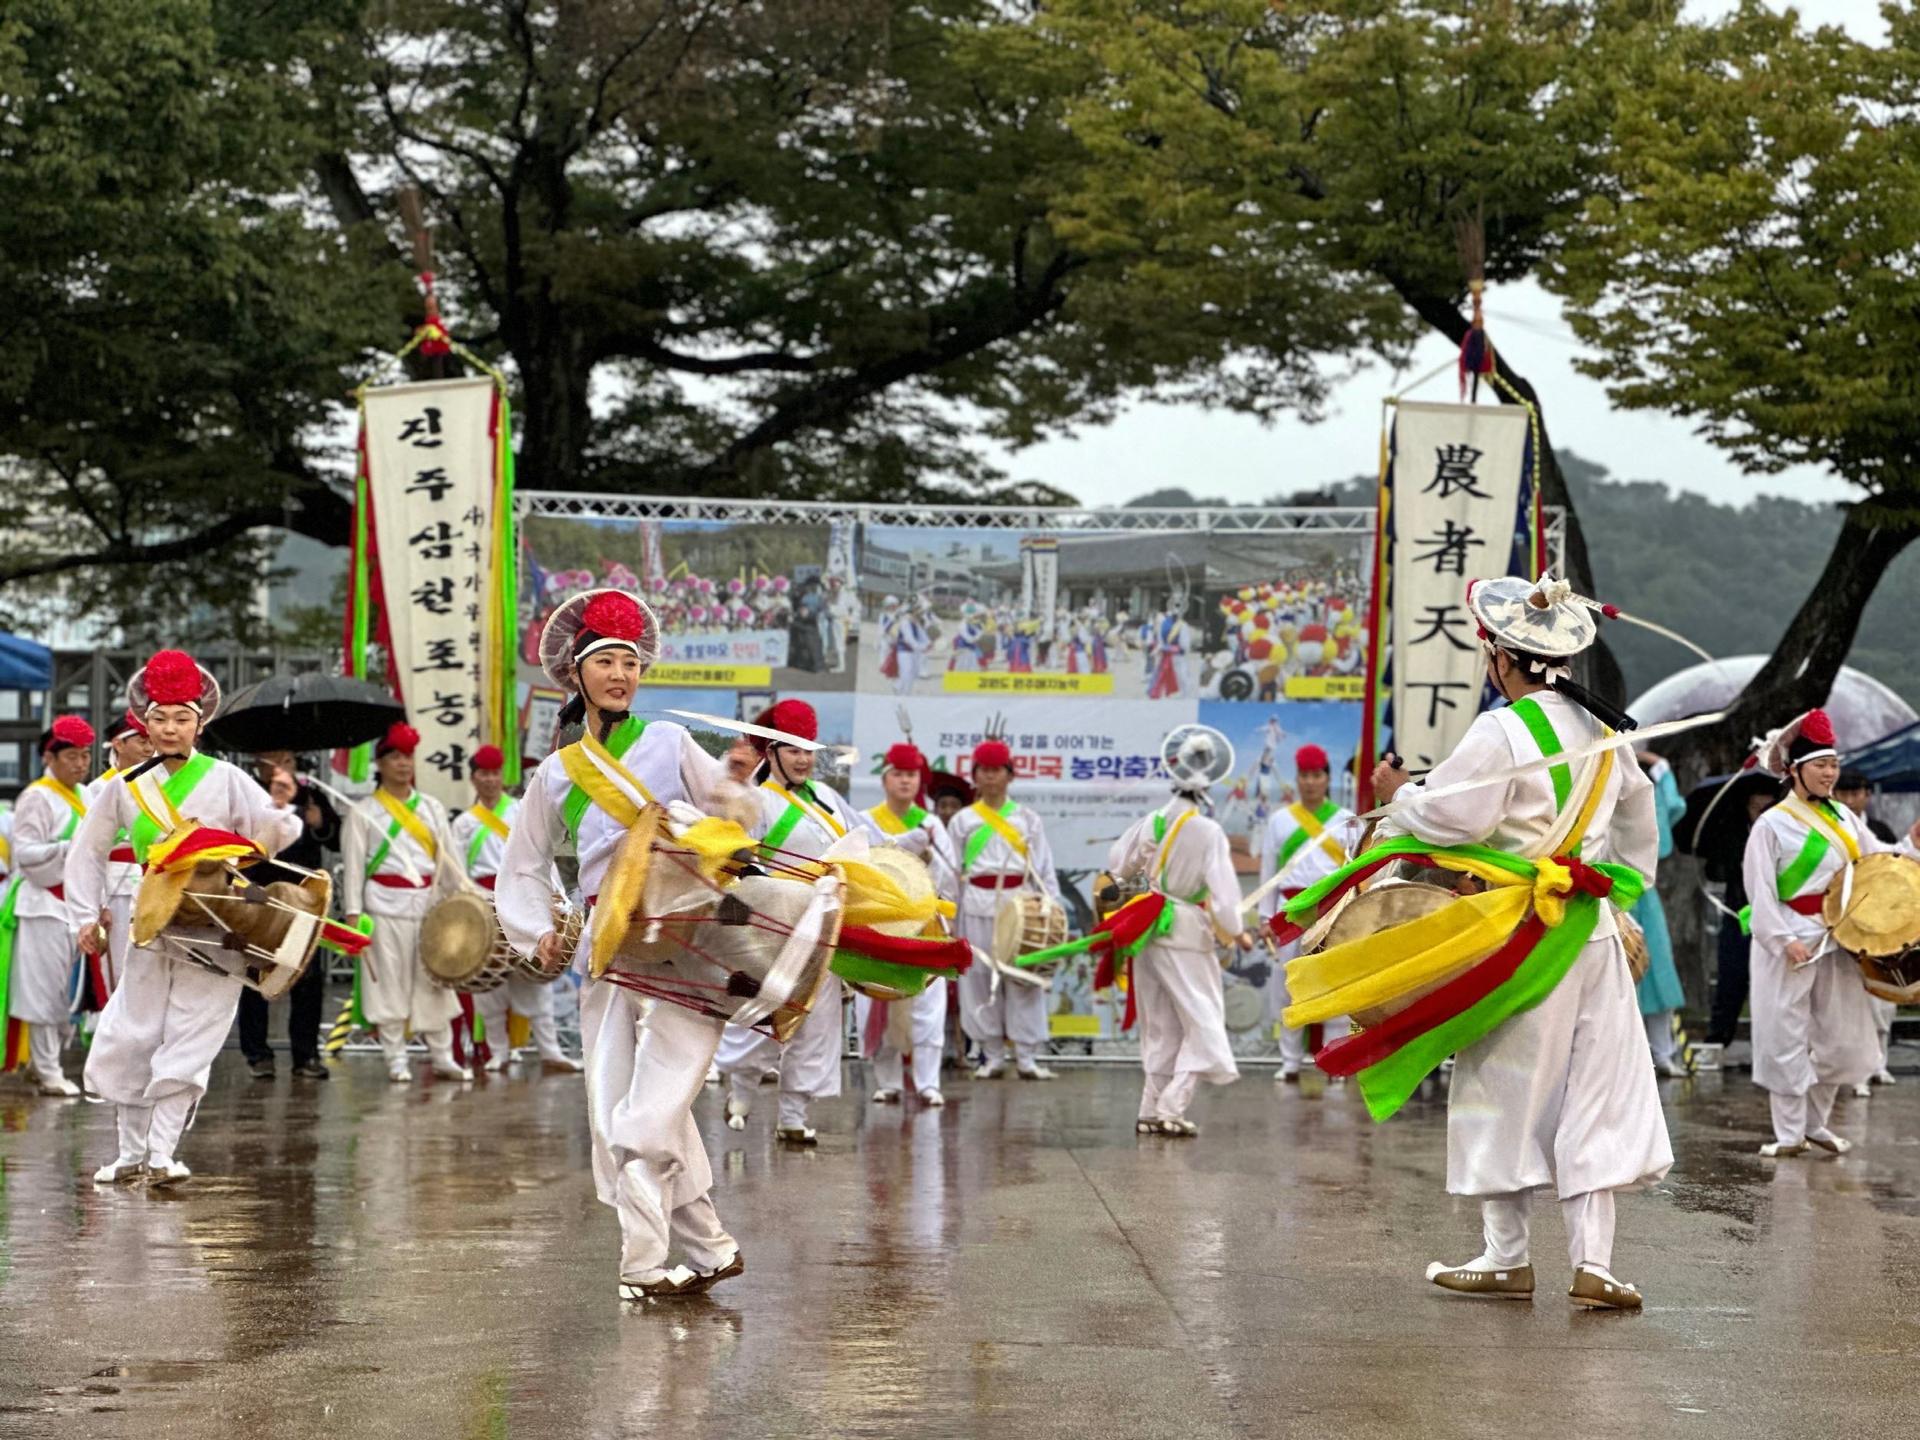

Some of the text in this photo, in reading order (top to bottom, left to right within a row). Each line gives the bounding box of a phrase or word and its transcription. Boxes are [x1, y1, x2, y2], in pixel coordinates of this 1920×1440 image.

[1406, 443, 1494, 766] 農者天下
[939, 732, 1115, 751] 진주문의 얼을 이어가는
[871, 753, 948, 776] 24
[956, 754, 1063, 780] 대민국
